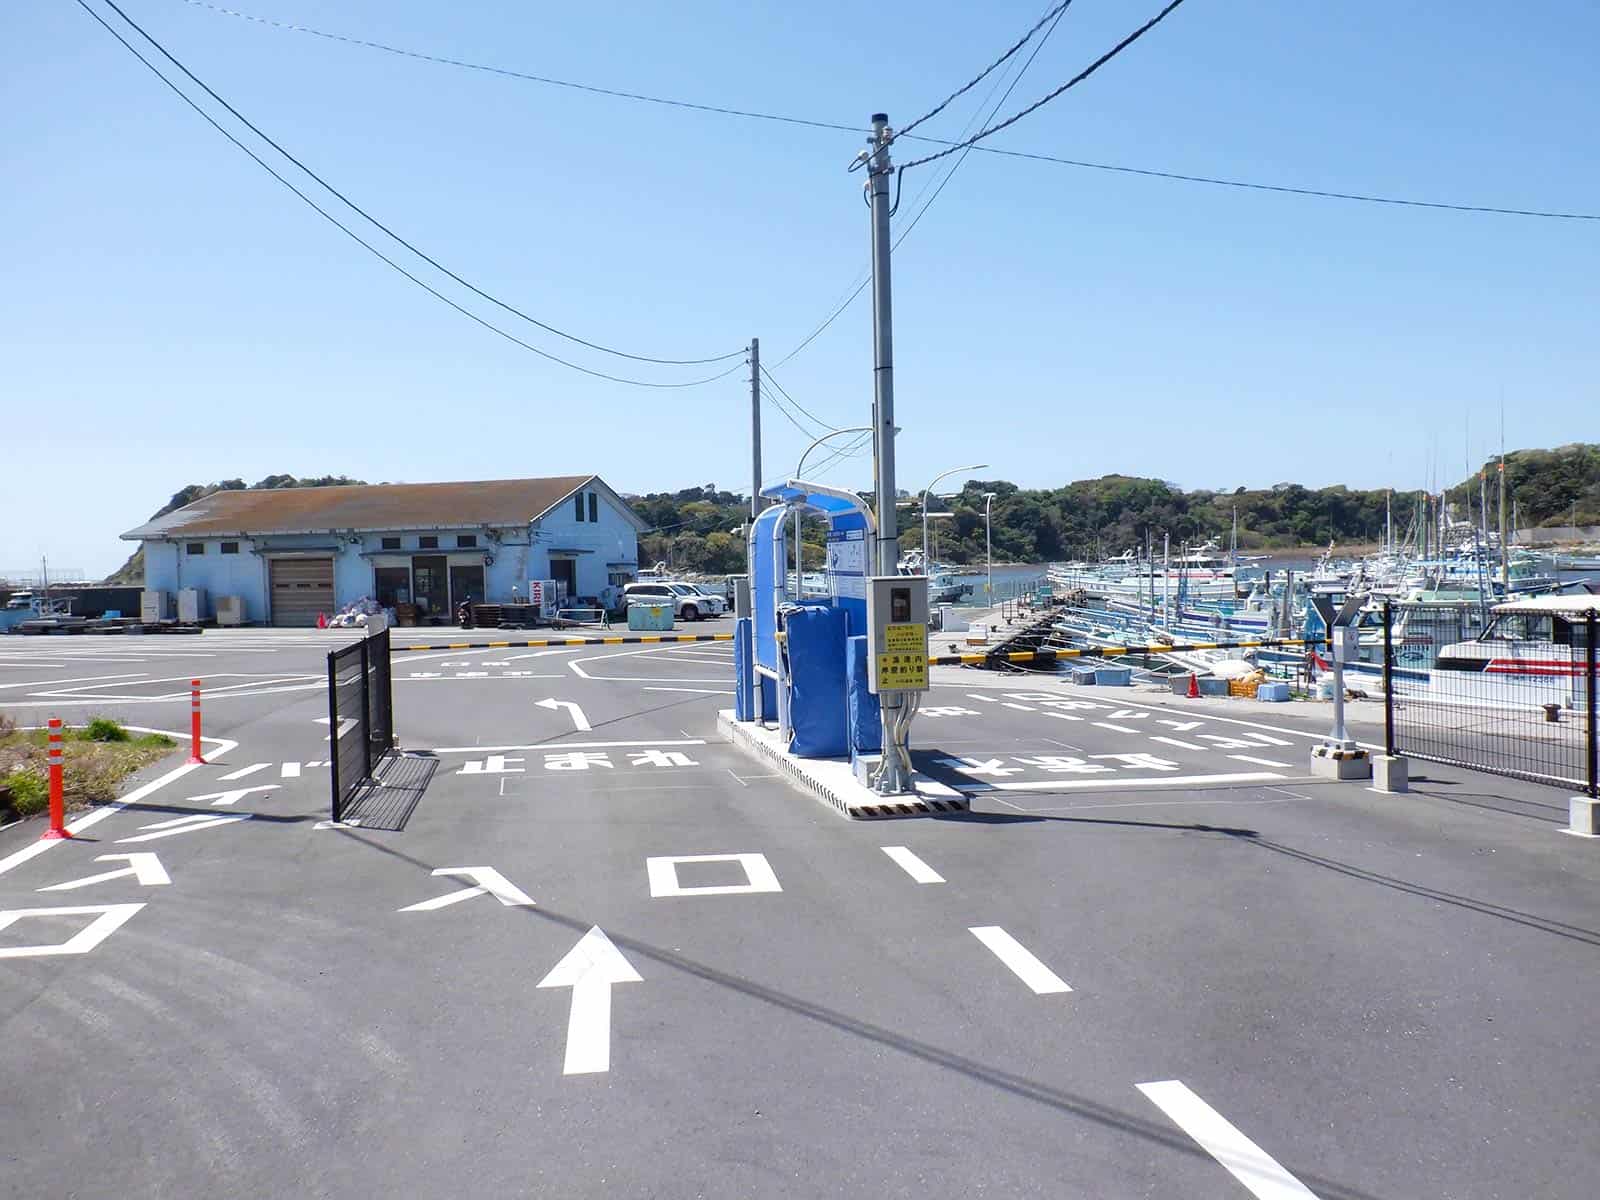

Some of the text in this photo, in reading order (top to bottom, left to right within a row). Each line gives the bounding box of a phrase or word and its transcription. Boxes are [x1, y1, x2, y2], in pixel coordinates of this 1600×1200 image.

[454, 750, 700, 775] 止まれ
[933, 752, 1180, 777] 止まれ
[399, 853, 783, 912] 入口
